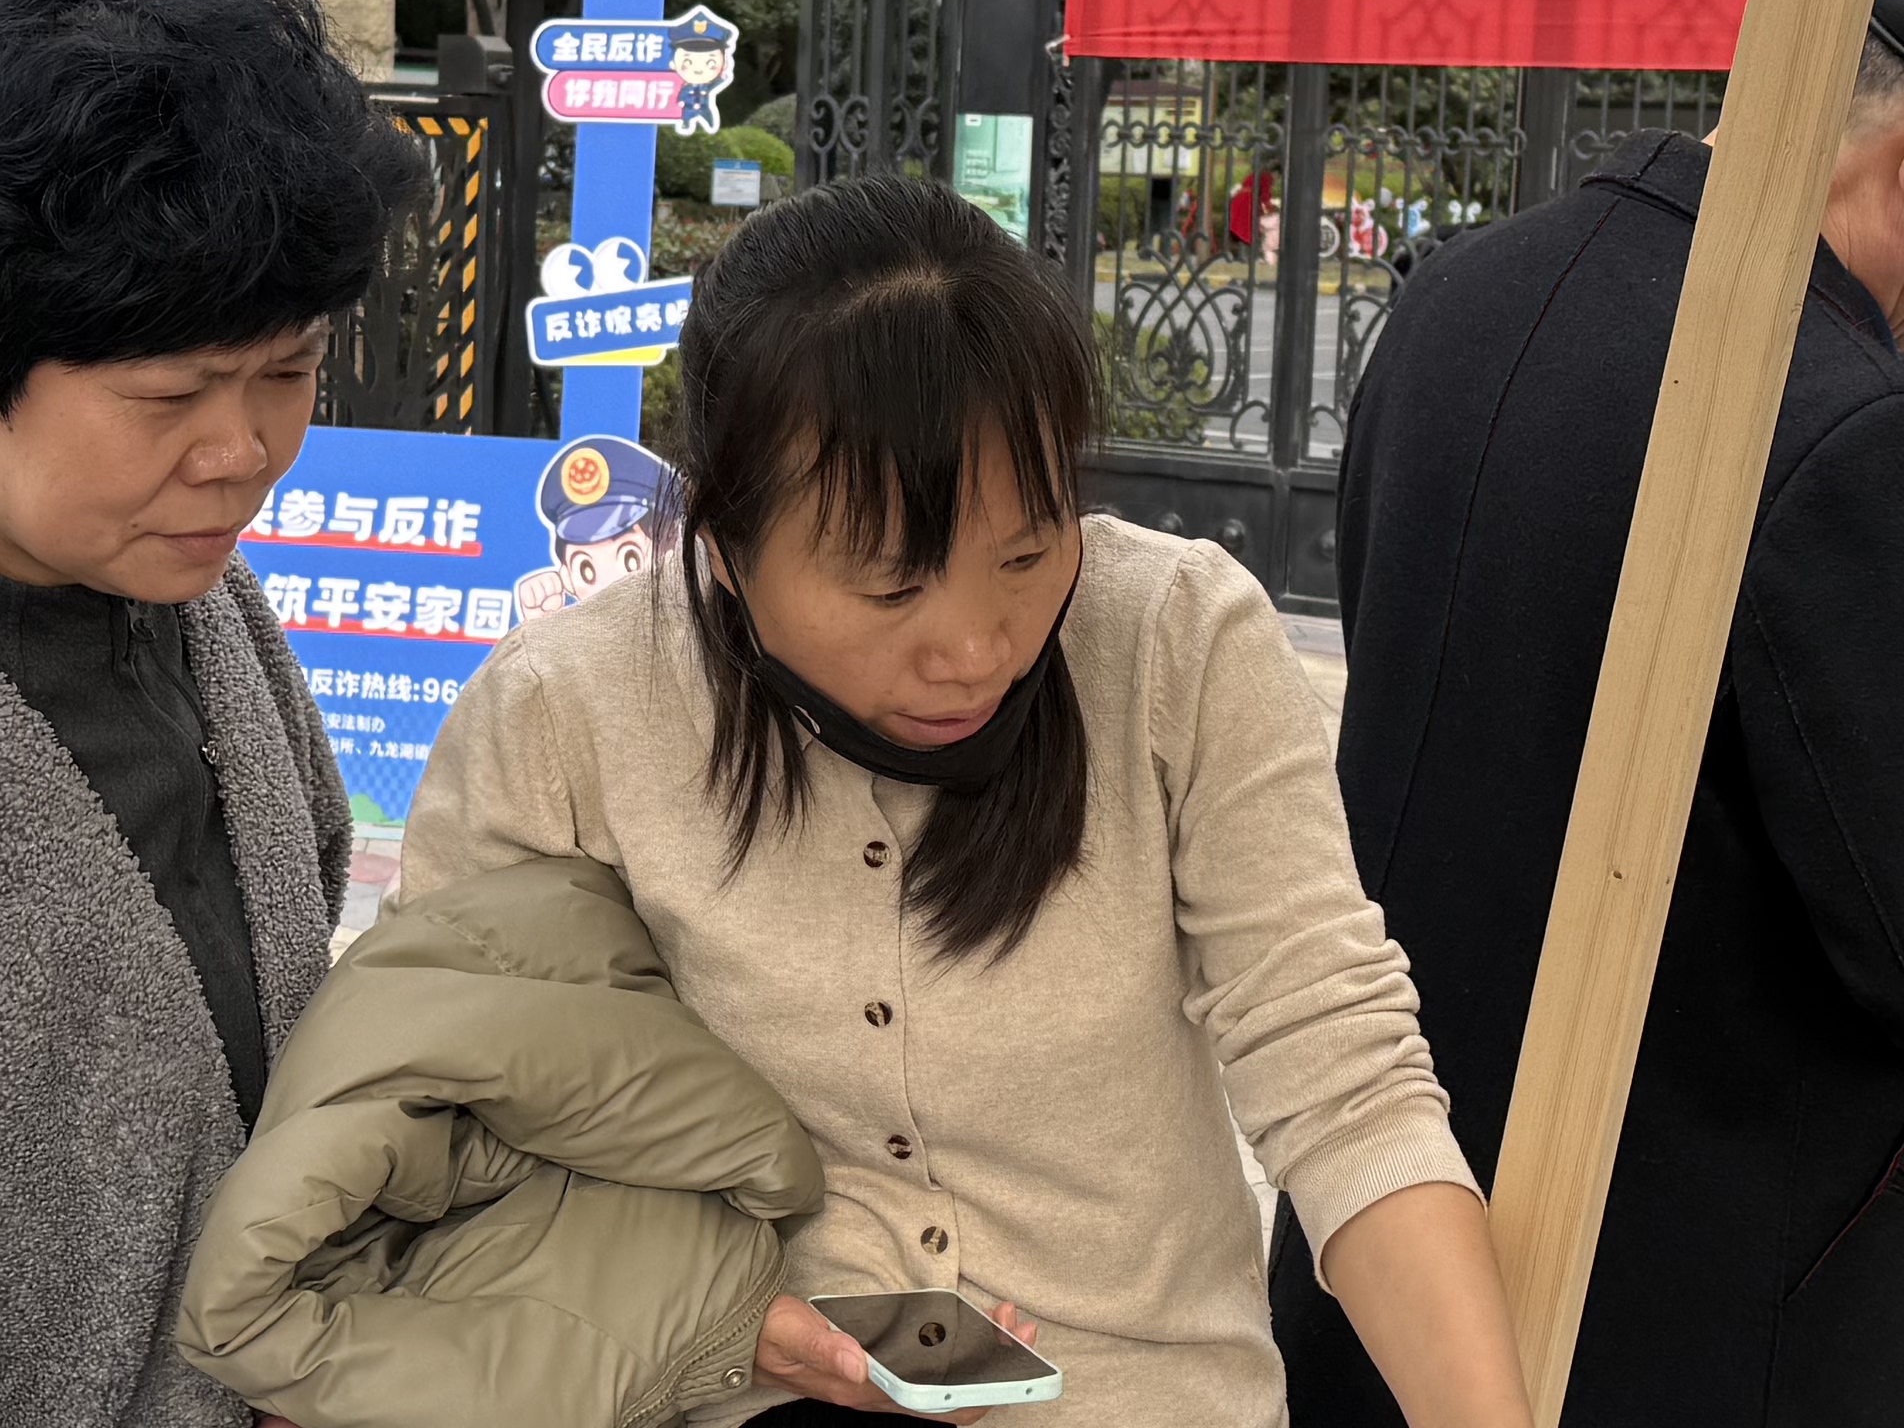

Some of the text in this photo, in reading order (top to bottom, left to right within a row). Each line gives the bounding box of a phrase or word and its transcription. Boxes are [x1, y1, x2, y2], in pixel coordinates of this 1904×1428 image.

[552, 32, 664, 62] 全民反诈
[564, 79, 674, 109] 你我同行
[301, 667, 467, 705] 反诈热线:96
